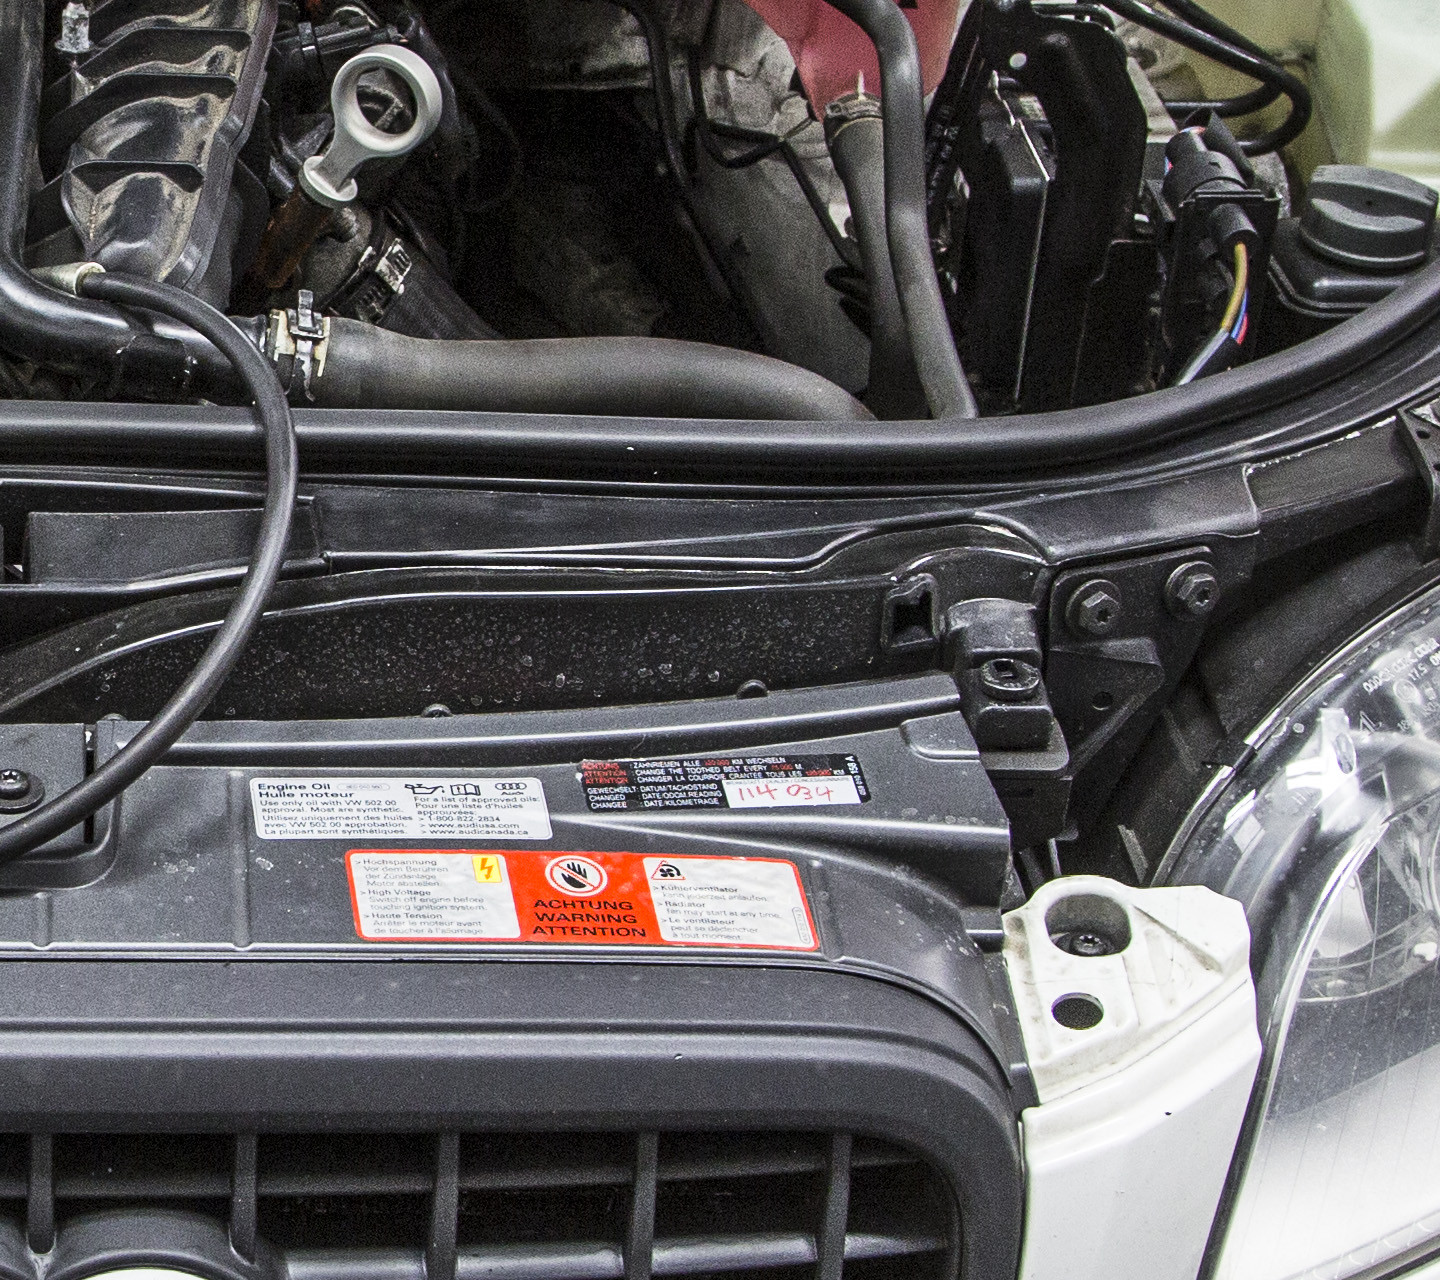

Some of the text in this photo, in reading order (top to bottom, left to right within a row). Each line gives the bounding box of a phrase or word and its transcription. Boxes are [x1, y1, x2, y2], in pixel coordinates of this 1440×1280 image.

[636, 768, 665, 776] CHANGE
[258, 783, 306, 791] Engine
[534, 900, 633, 910] ACHTUNG
[534, 912, 637, 923] WARNING
[533, 925, 646, 937] ATTENTION
